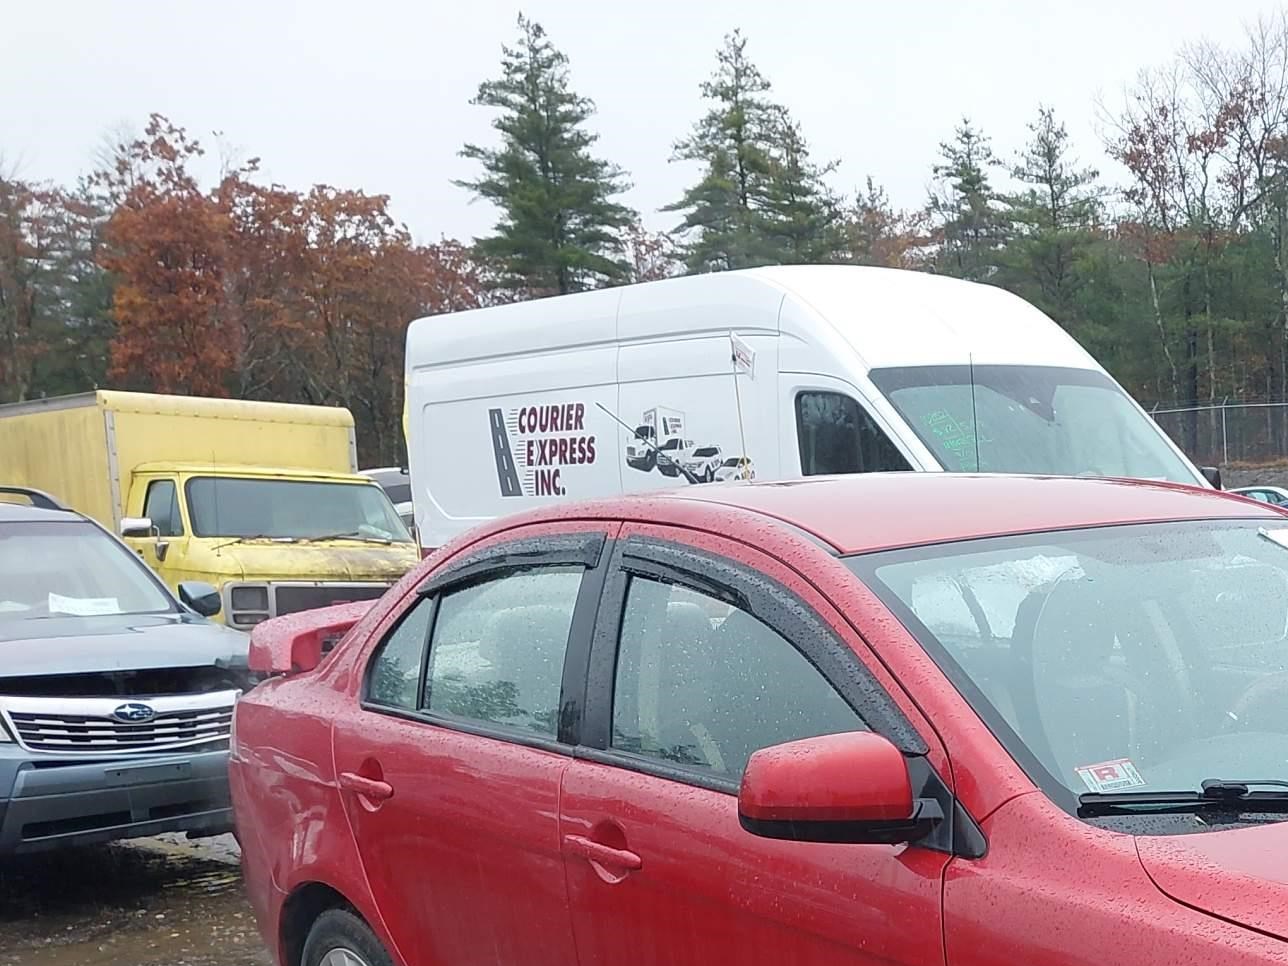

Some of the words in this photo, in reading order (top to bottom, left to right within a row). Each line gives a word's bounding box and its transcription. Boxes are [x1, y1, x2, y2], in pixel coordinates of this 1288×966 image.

[518, 403, 585, 434] COURIER
[527, 436, 596, 467] EXPRESS
[535, 468, 566, 496] INC.
[1094, 767, 1120, 781] R
